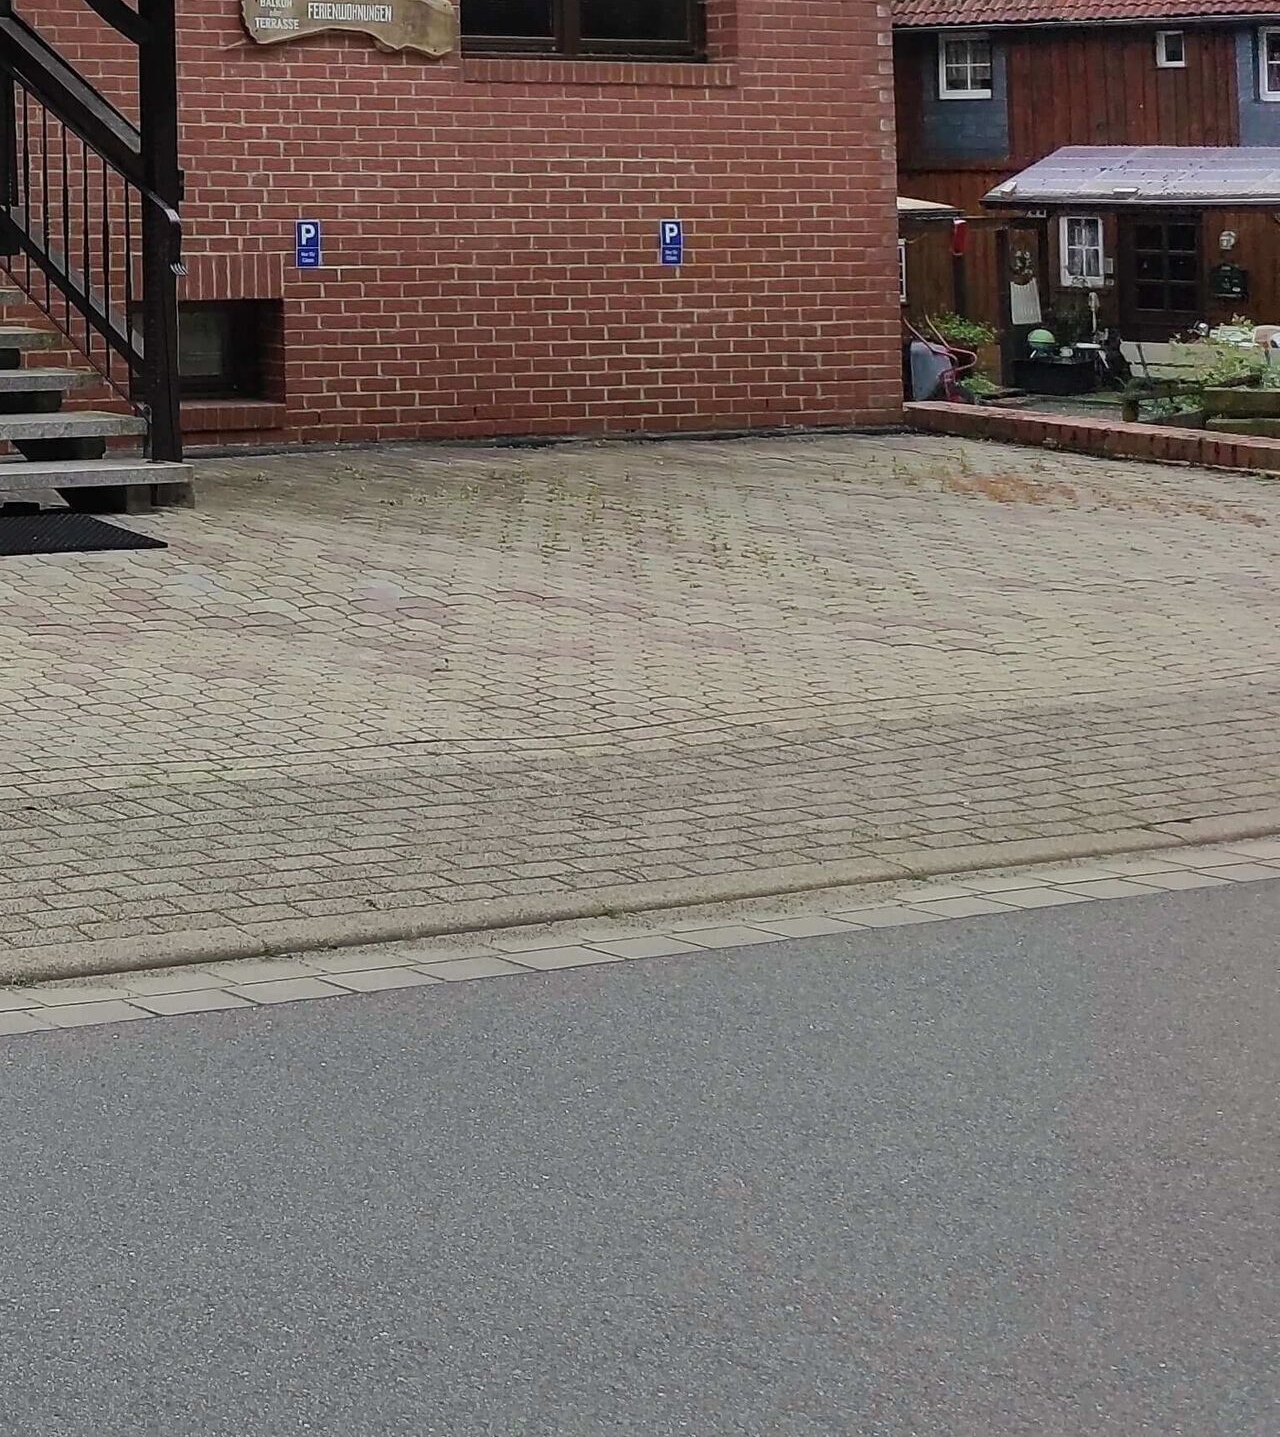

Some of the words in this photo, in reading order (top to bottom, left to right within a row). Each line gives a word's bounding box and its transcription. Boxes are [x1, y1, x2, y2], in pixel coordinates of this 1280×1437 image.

[307, 2, 392, 22] FERIENWOHNUNGEN
[255, 17, 299, 30] TERRASSE
[301, 224, 315, 246] P
[665, 223, 678, 244] P
